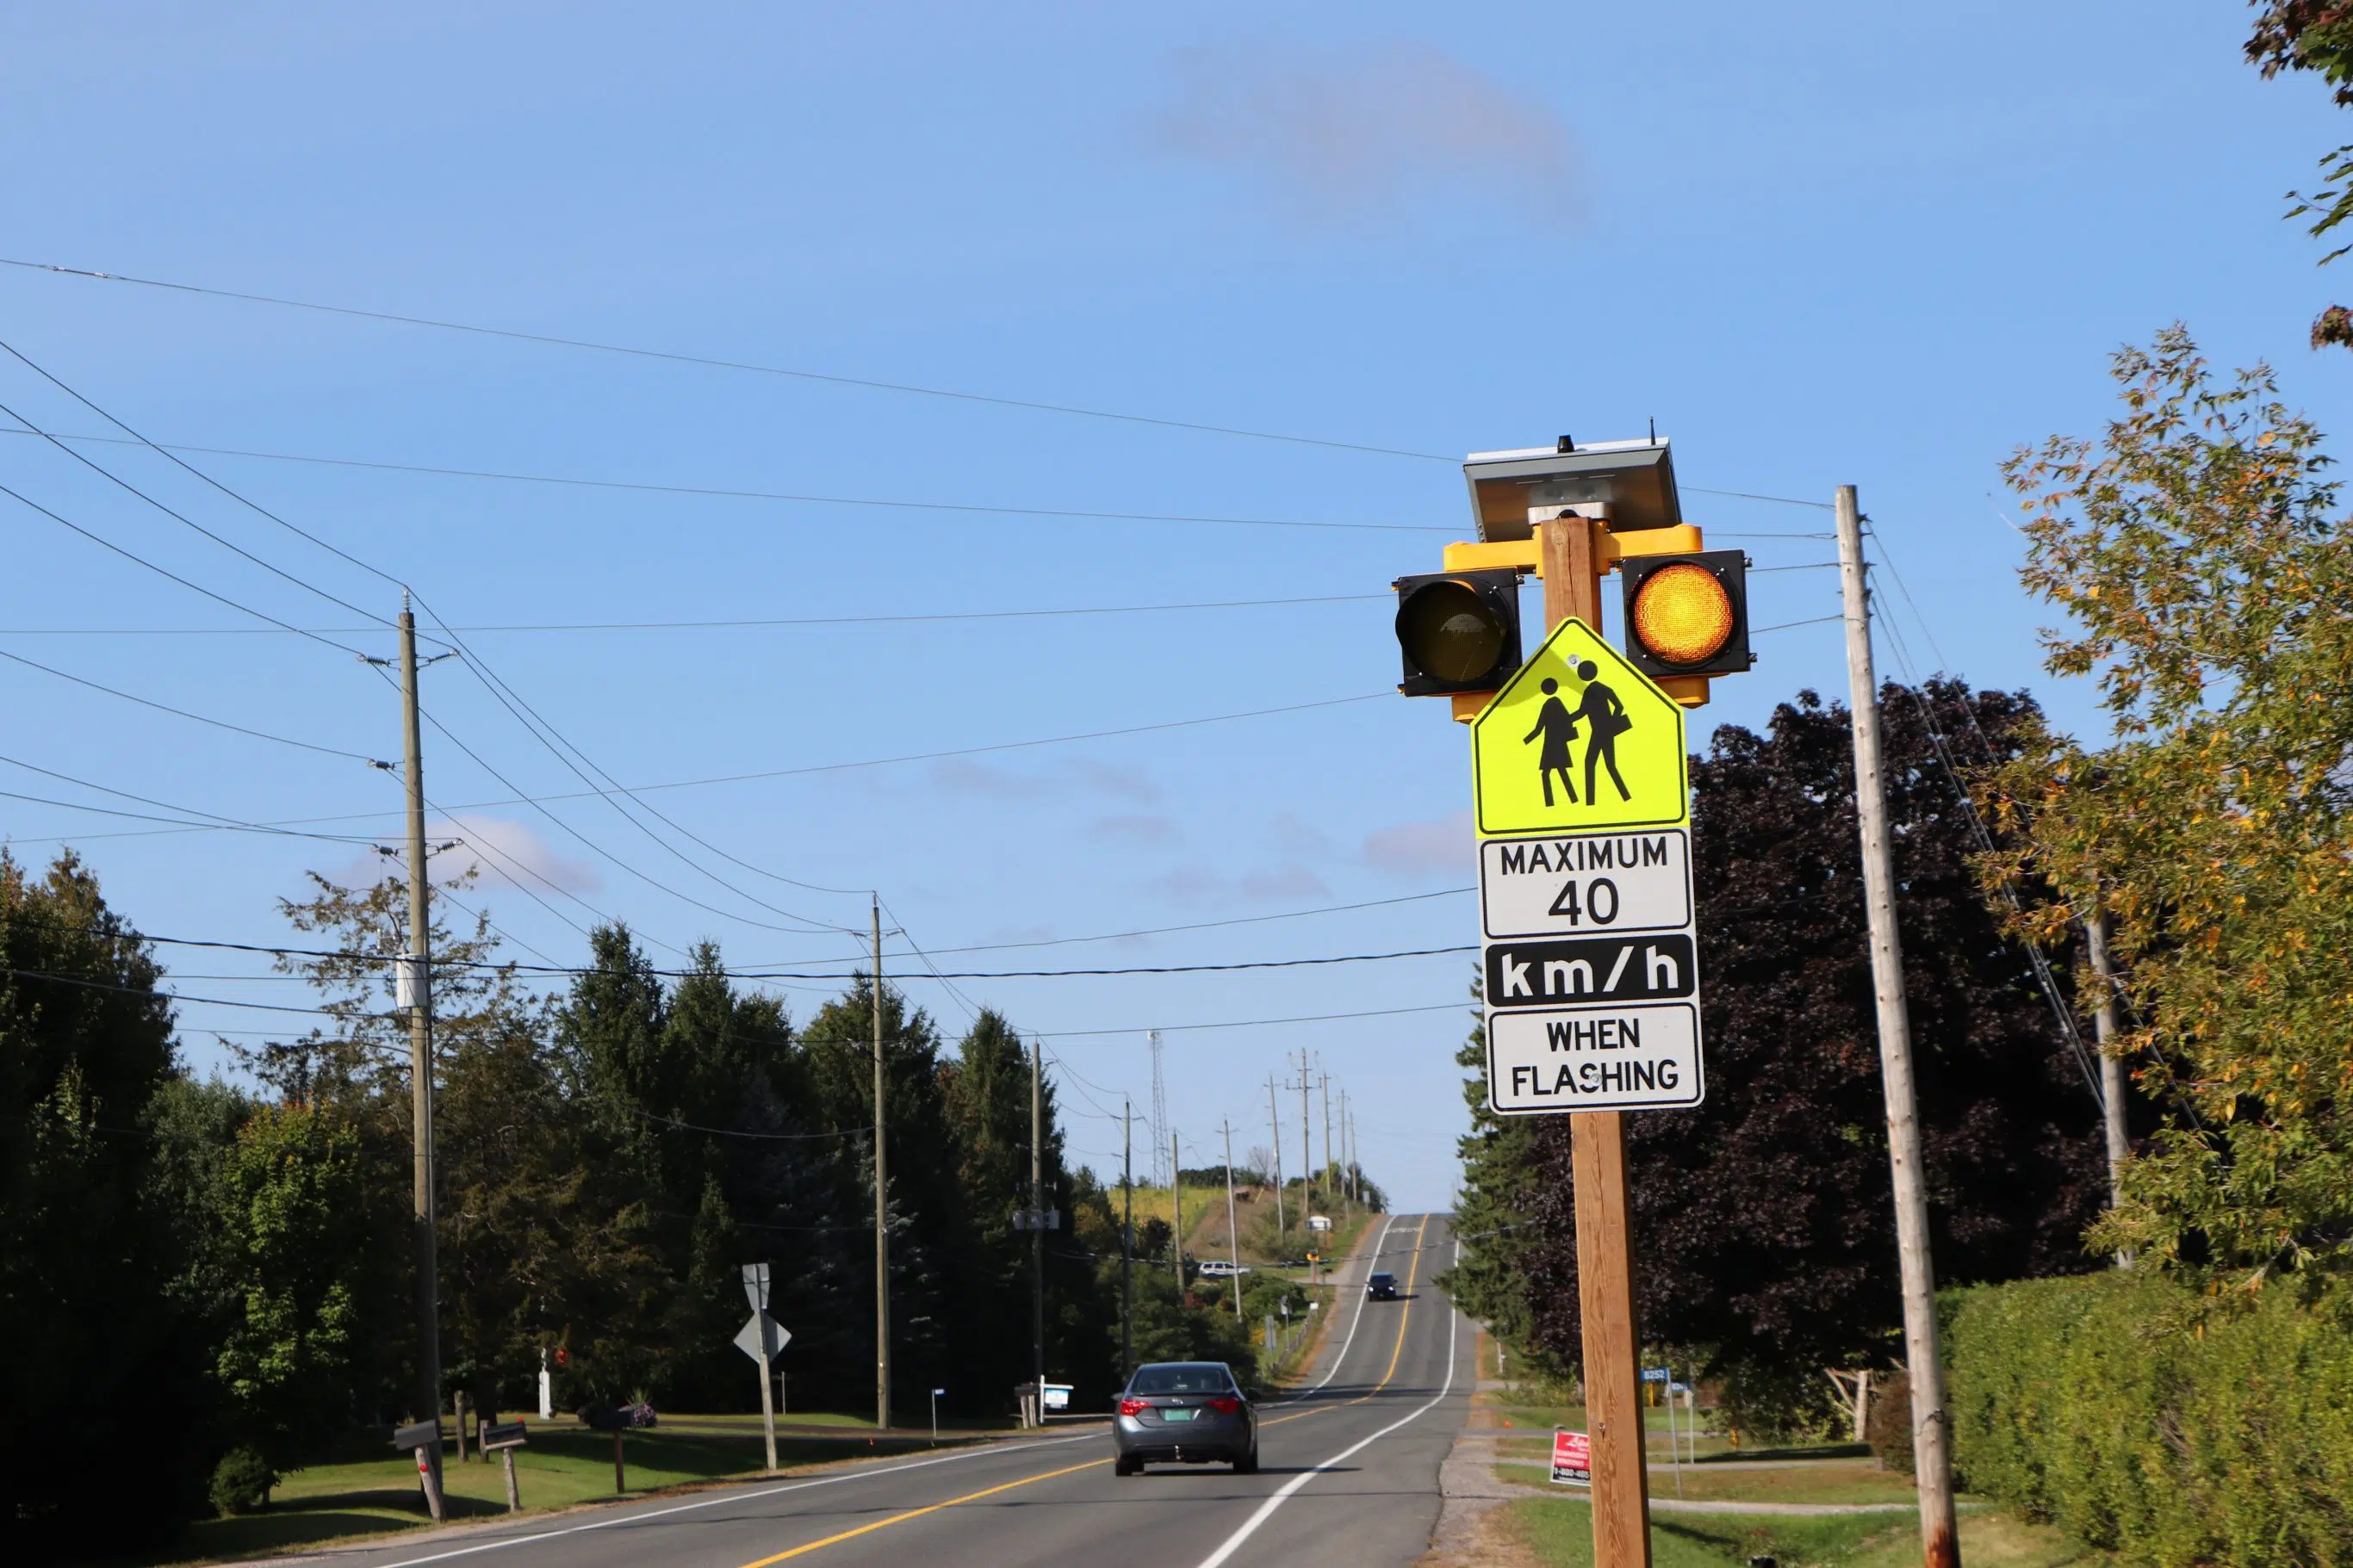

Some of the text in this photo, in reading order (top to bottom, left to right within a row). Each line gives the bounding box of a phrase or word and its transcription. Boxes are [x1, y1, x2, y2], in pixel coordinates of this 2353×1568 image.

[1501, 836, 1667, 875] MAXIMUM
[1548, 877, 1619, 926] 40
[1501, 945, 1679, 997] km/h
[1546, 1018, 1640, 1051] WHEN
[1512, 1059, 1679, 1096] FLASHING
